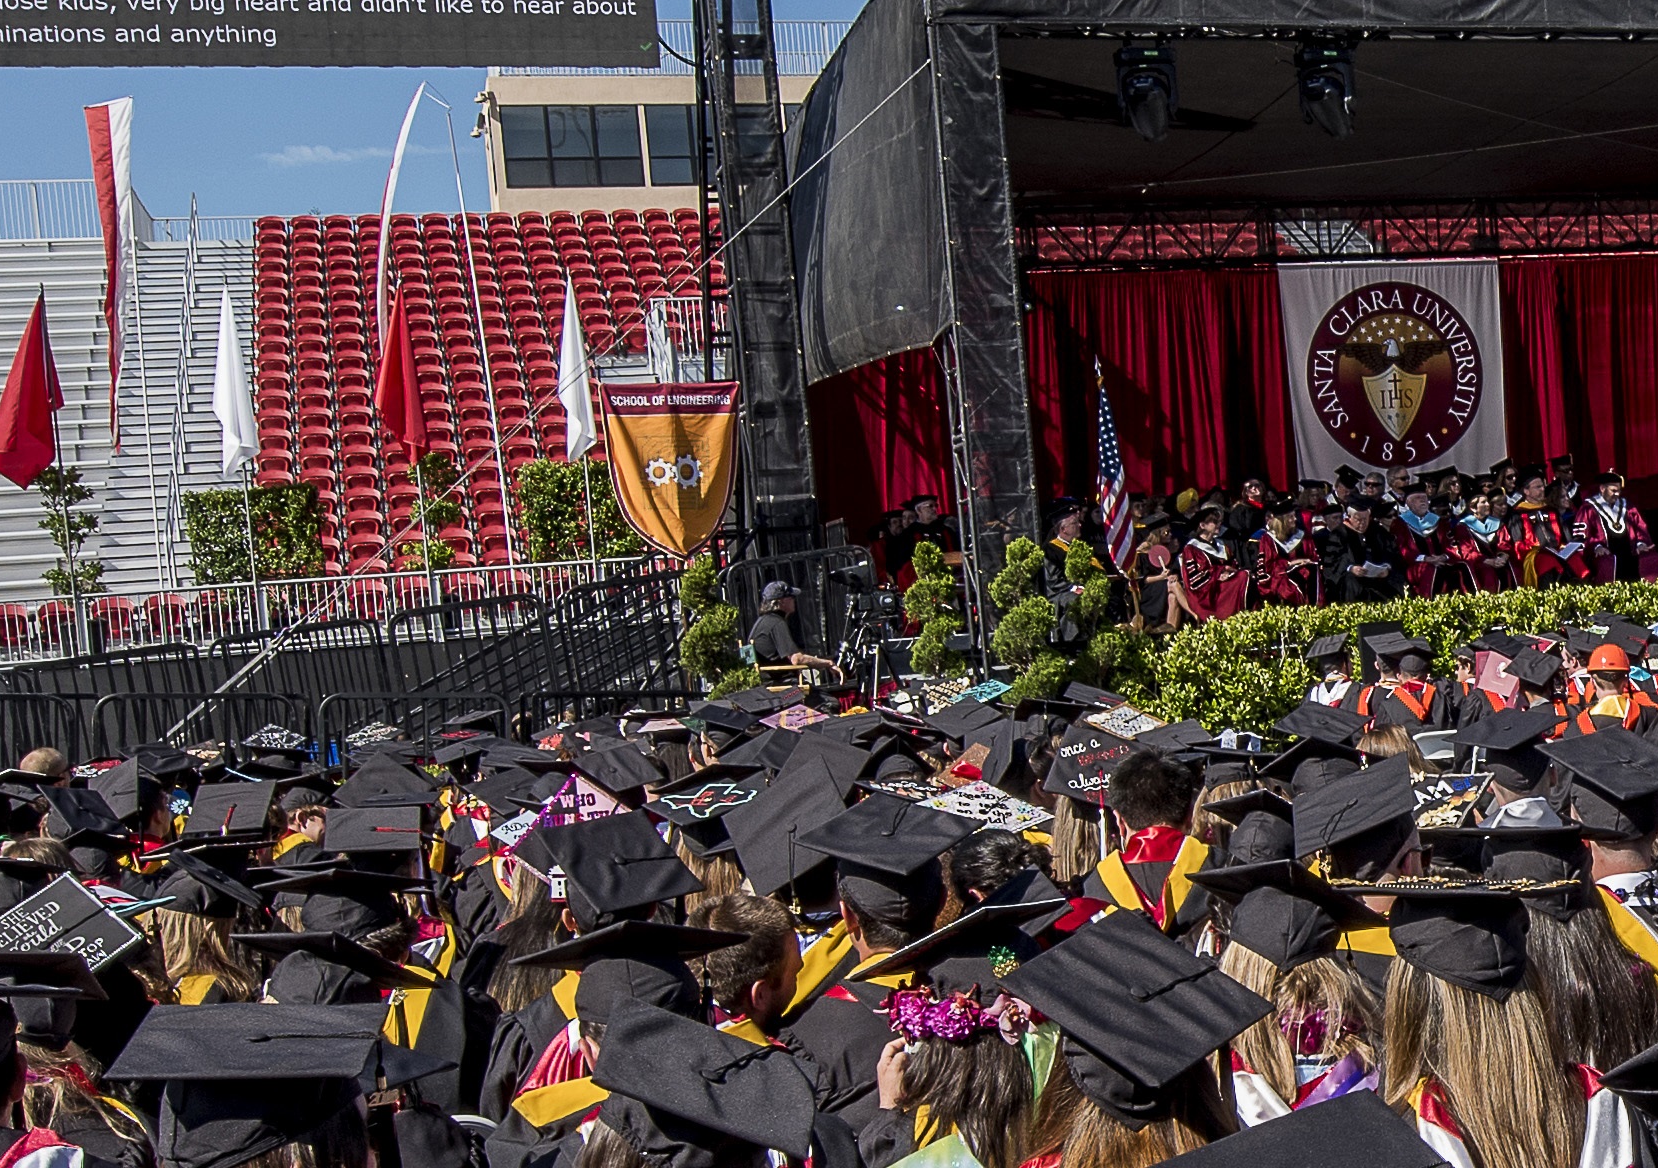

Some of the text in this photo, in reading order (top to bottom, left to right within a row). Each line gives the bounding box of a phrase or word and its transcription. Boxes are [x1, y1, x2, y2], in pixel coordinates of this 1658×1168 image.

[115, 23, 161, 43] and
[170, 24, 277, 48] anything
[1314, 289, 1478, 429] SANTA CLARA UNIVERSITY
[610, 394, 731, 406] SCHOOL OF ENGINEERING
[1358, 432, 1441, 463] 1851
[1060, 738, 1101, 758] once a
[559, 793, 597, 808] WHO
[0, 908, 30, 930] SHE
